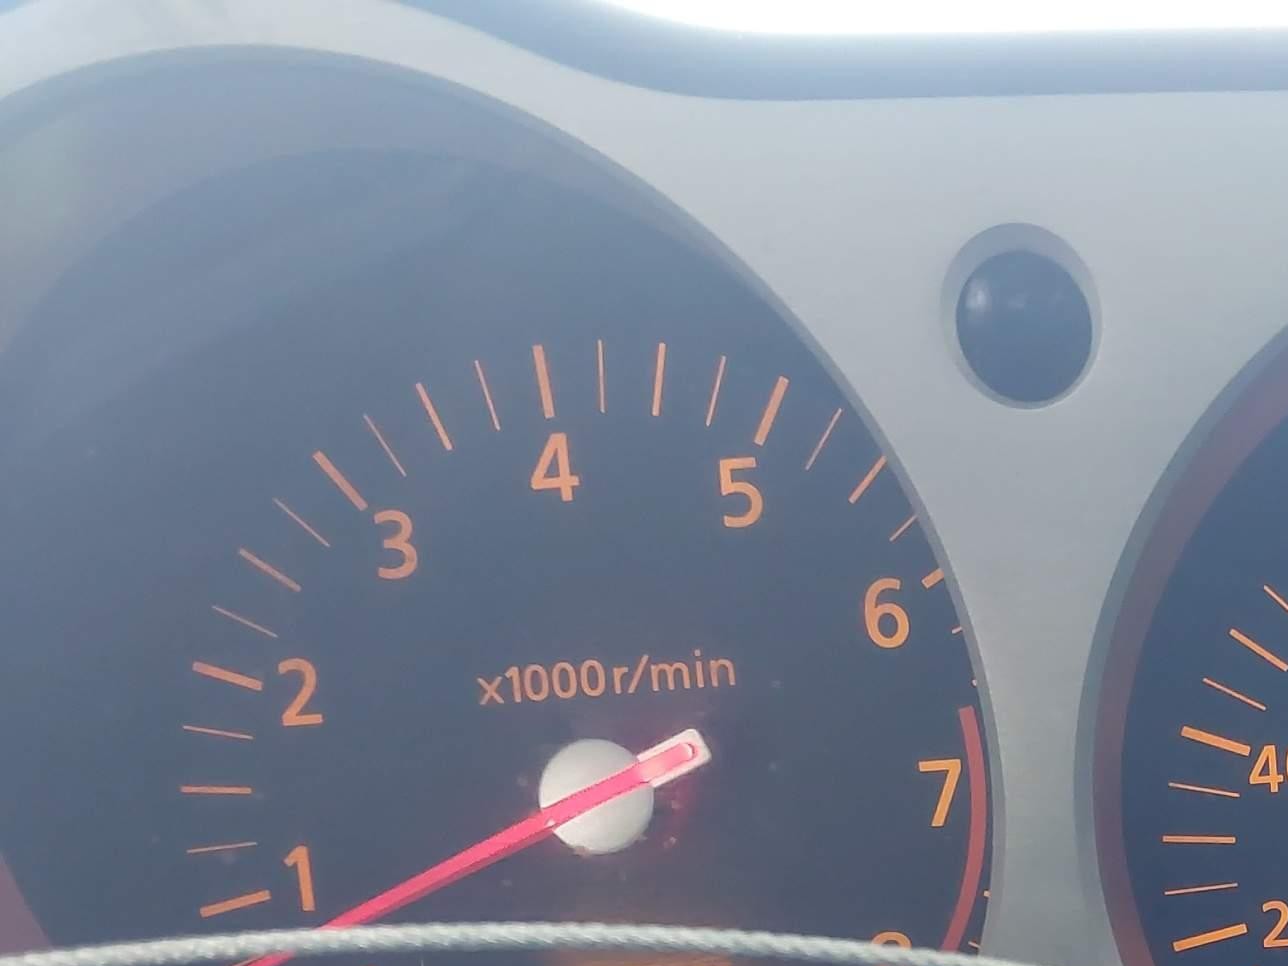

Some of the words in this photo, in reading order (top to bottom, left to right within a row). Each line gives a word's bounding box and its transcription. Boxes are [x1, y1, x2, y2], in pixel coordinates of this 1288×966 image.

[530, 432, 580, 501] 4
[718, 457, 764, 528] 5
[373, 510, 418, 579] 3
[863, 578, 910, 649] 6
[277, 658, 324, 726] 2
[918, 758, 962, 827] 7
[283, 845, 315, 911] 1
